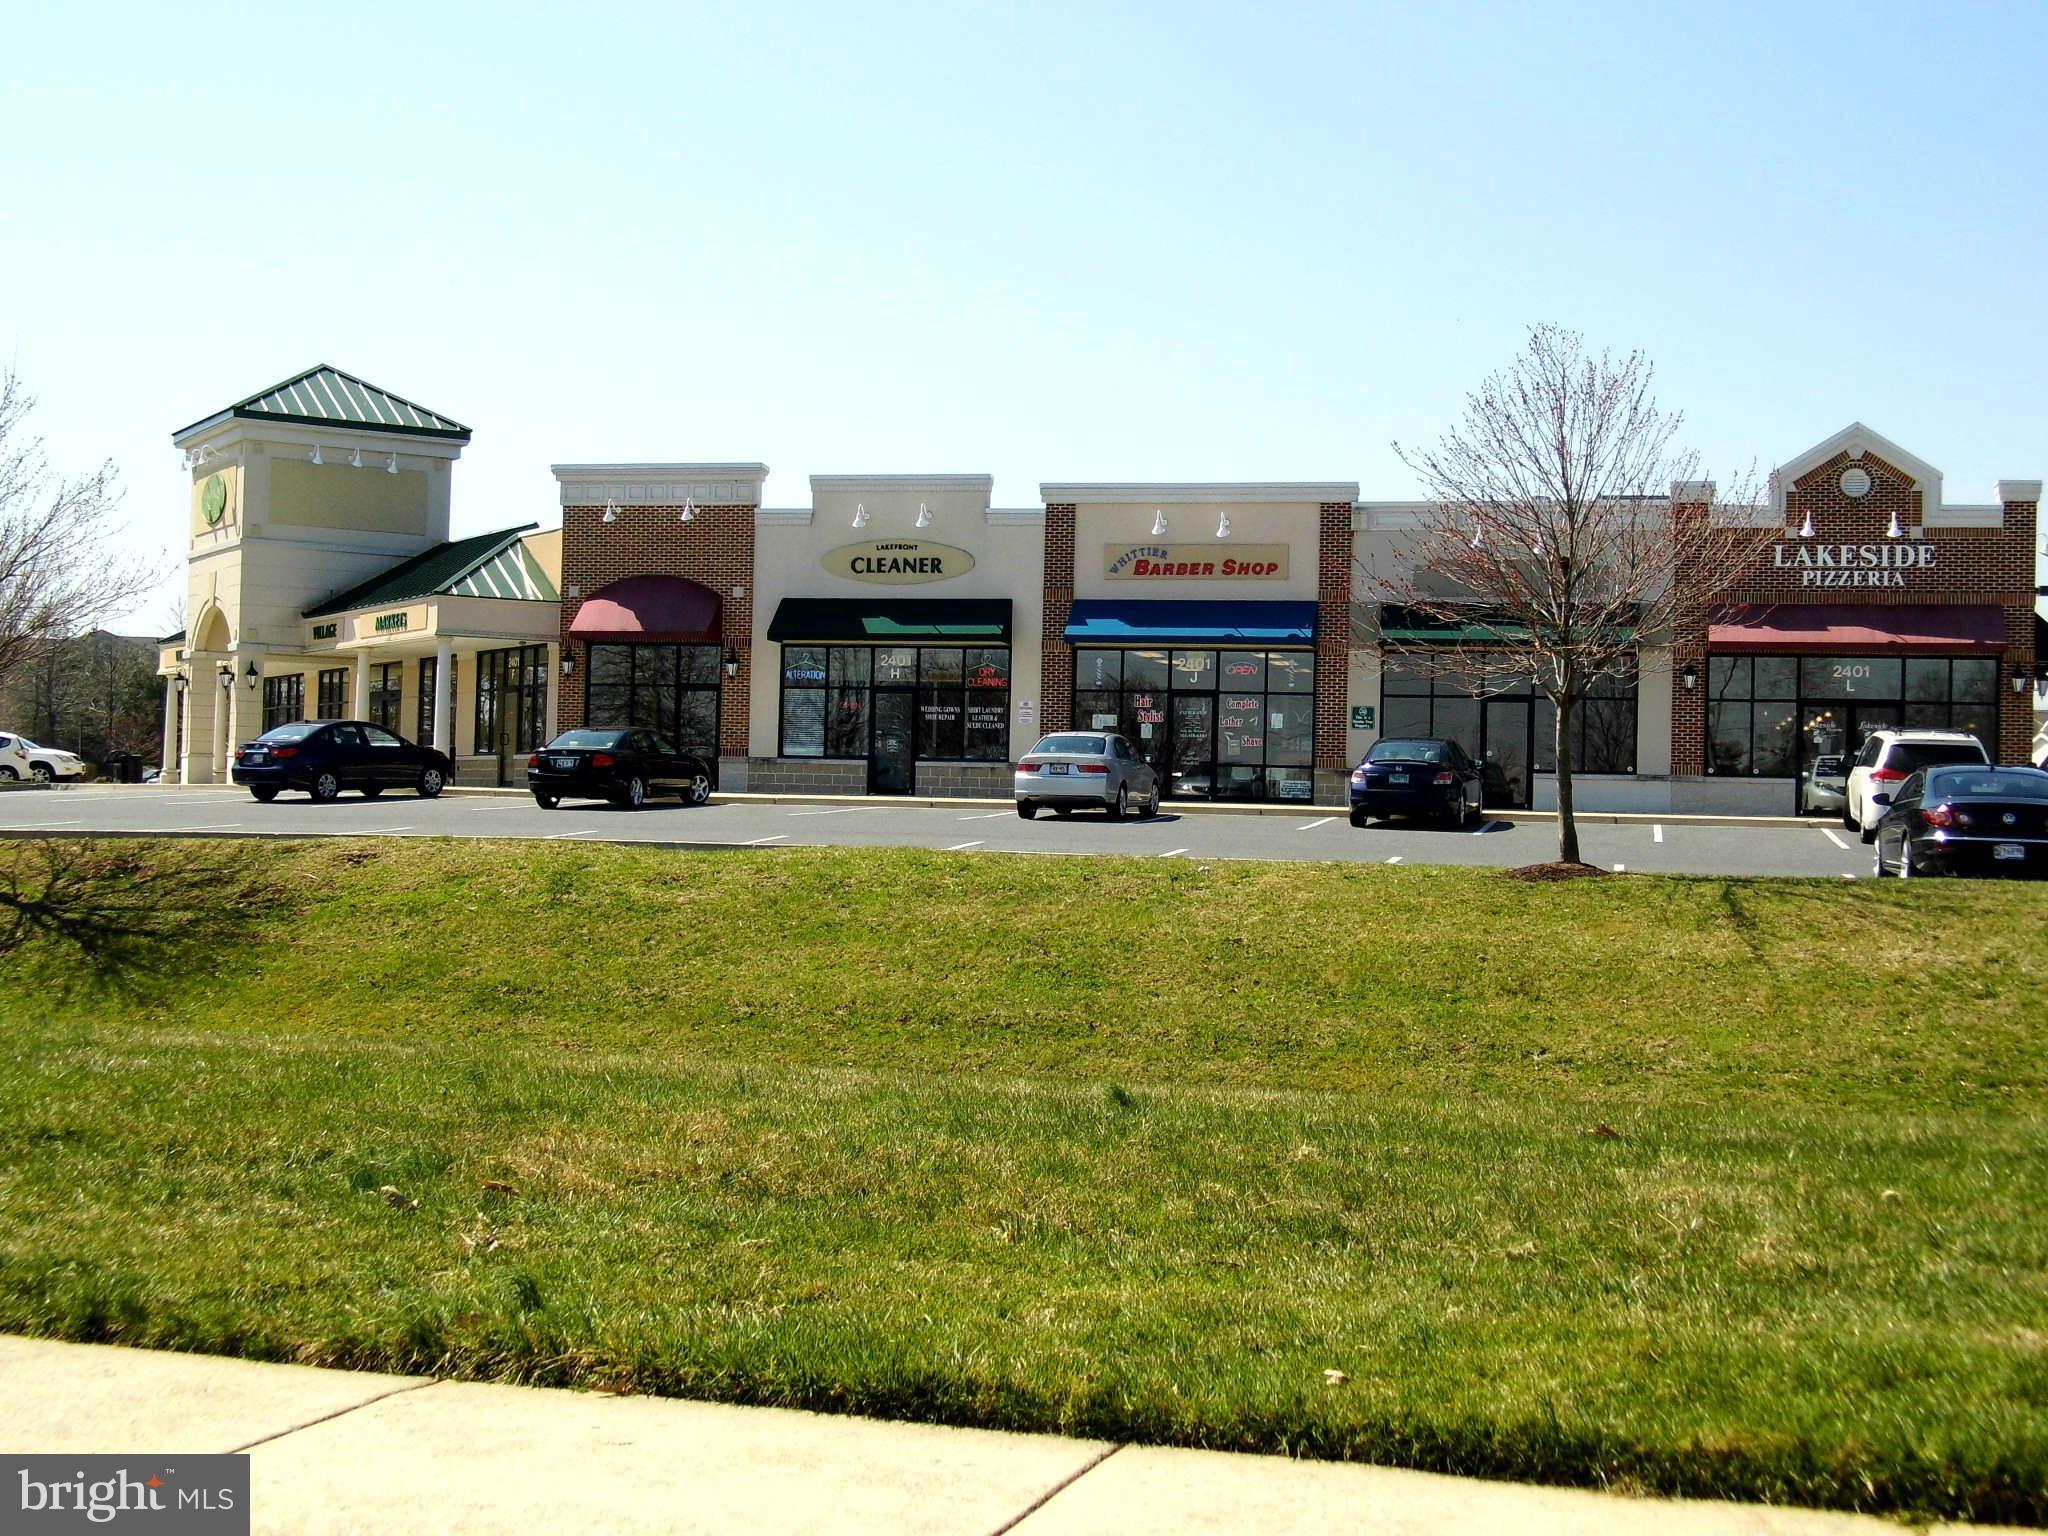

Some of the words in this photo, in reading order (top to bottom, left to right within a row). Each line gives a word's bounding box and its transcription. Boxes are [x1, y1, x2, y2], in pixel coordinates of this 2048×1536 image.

[1109, 547, 1168, 574] WHITTIER
[1773, 544, 1937, 567] LAKESIDE
[850, 557, 943, 574] CLEANER
[1133, 559, 1215, 576] BARBER
[1221, 559, 1279, 576] SHOP
[1802, 570, 1905, 587] PIZZERIA
[880, 655, 912, 667] 2401
[1176, 657, 1212, 670] 2401
[785, 670, 826, 680] ALTERATION
[890, 668, 900, 679] H
[978, 668, 995, 677] DRY
[1228, 665, 1257, 674] OPEN
[1833, 665, 1870, 678] 2401
[967, 678, 1007, 687] CLEANING
[1189, 671, 1198, 683] J
[1846, 680, 1856, 692] L
[1134, 695, 1153, 707] Hair
[1226, 697, 1259, 710] Complete
[1137, 710, 1164, 722] Stylist
[1241, 735, 1263, 747] Shave
